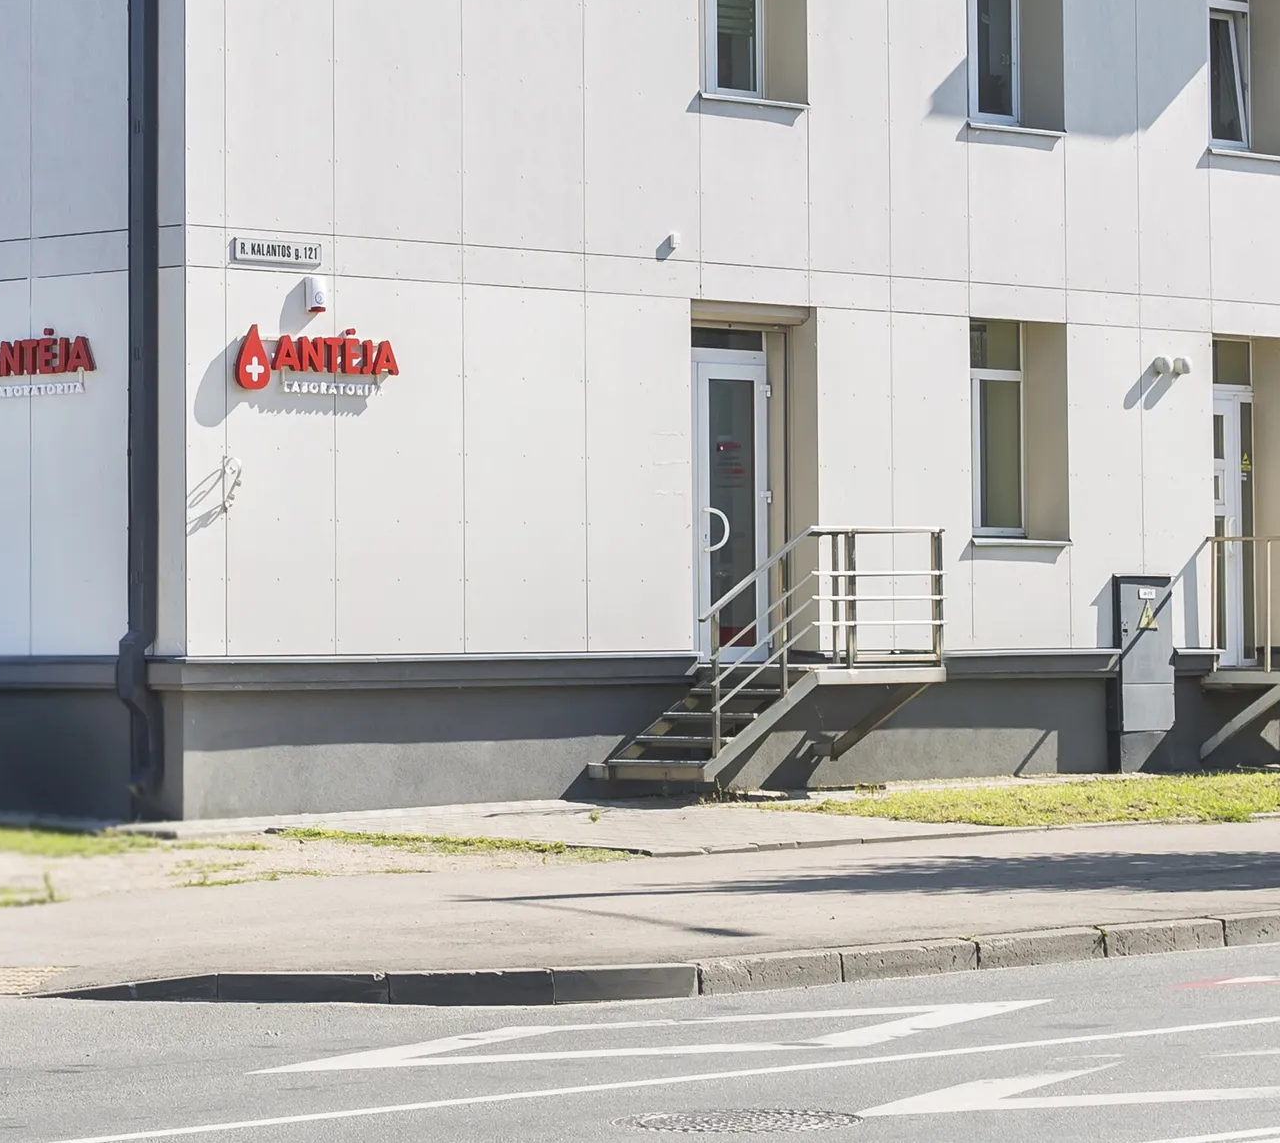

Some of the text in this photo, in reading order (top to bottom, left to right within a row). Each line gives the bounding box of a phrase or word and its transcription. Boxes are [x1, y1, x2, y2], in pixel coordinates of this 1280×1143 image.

[240, 242, 318, 261] R. KALANTOS g. 121
[271, 328, 399, 376] ANTĖJA
[283, 380, 384, 396] LABORATORIJA
